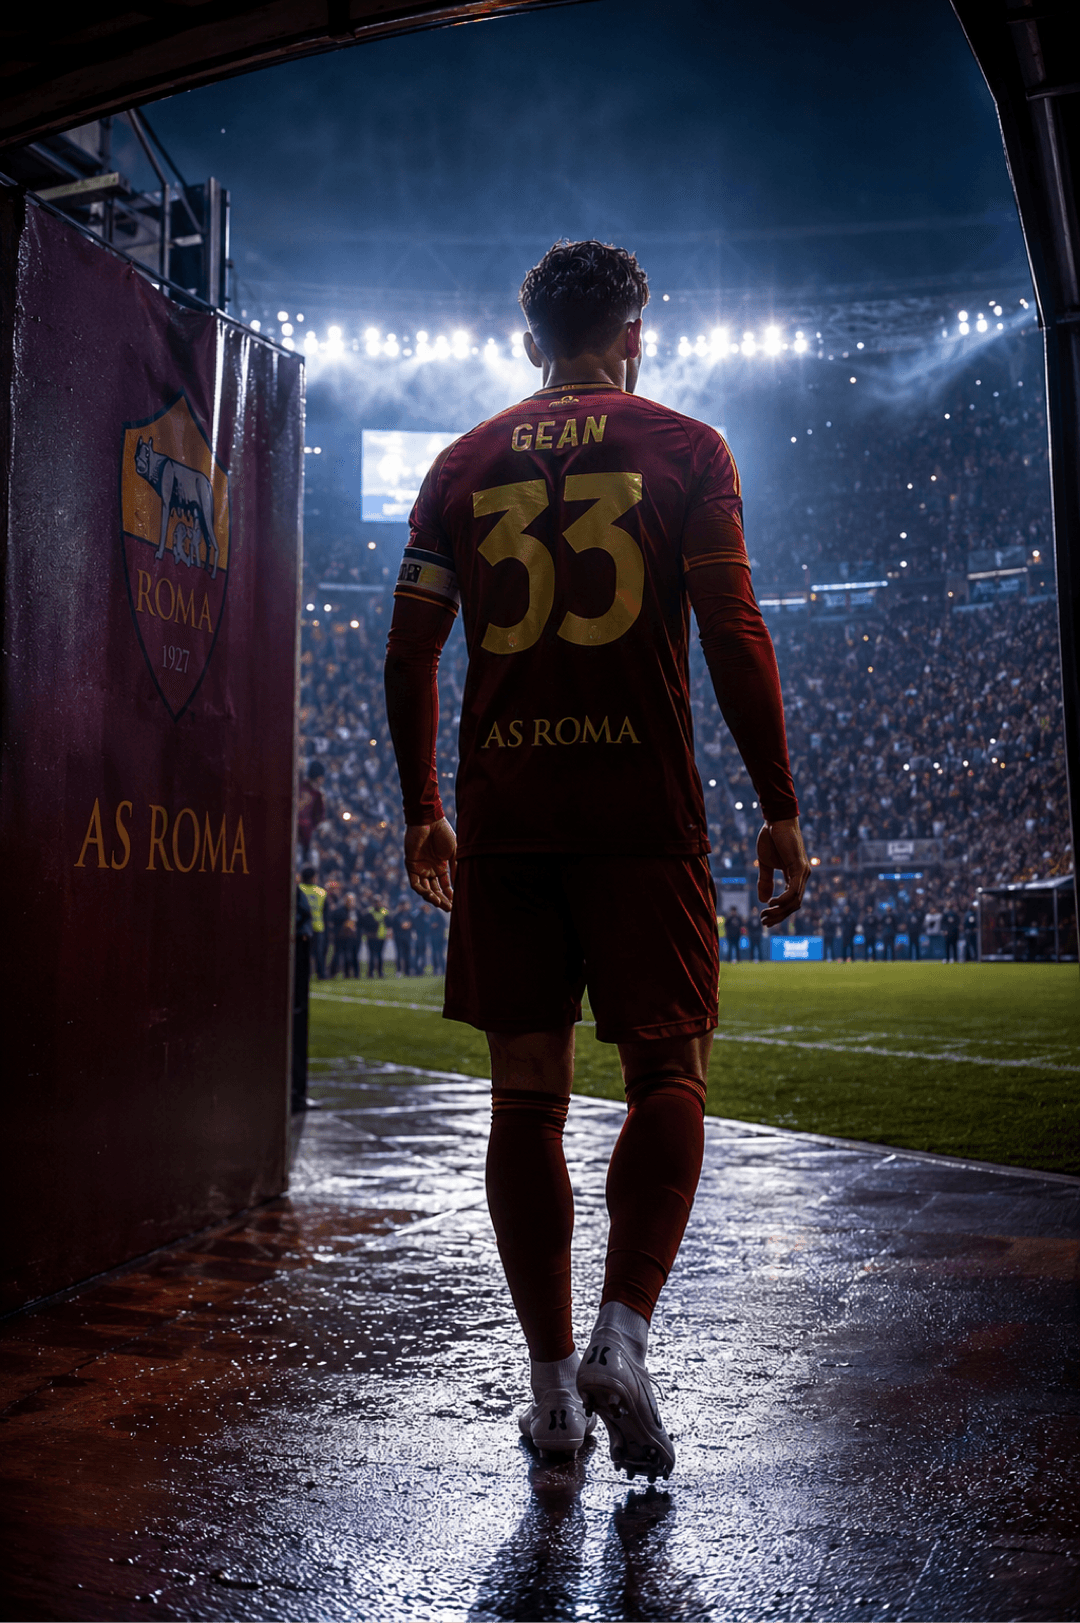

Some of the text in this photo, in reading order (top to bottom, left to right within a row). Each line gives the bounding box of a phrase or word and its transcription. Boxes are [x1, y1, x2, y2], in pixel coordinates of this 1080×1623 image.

[511, 414, 608, 452] GEAN
[472, 471, 645, 656] 33
[136, 568, 214, 634] ROMA
[161, 643, 191, 675] 1927
[481, 715, 642, 749] AS ROMA
[74, 797, 251, 875] AS ROMA
